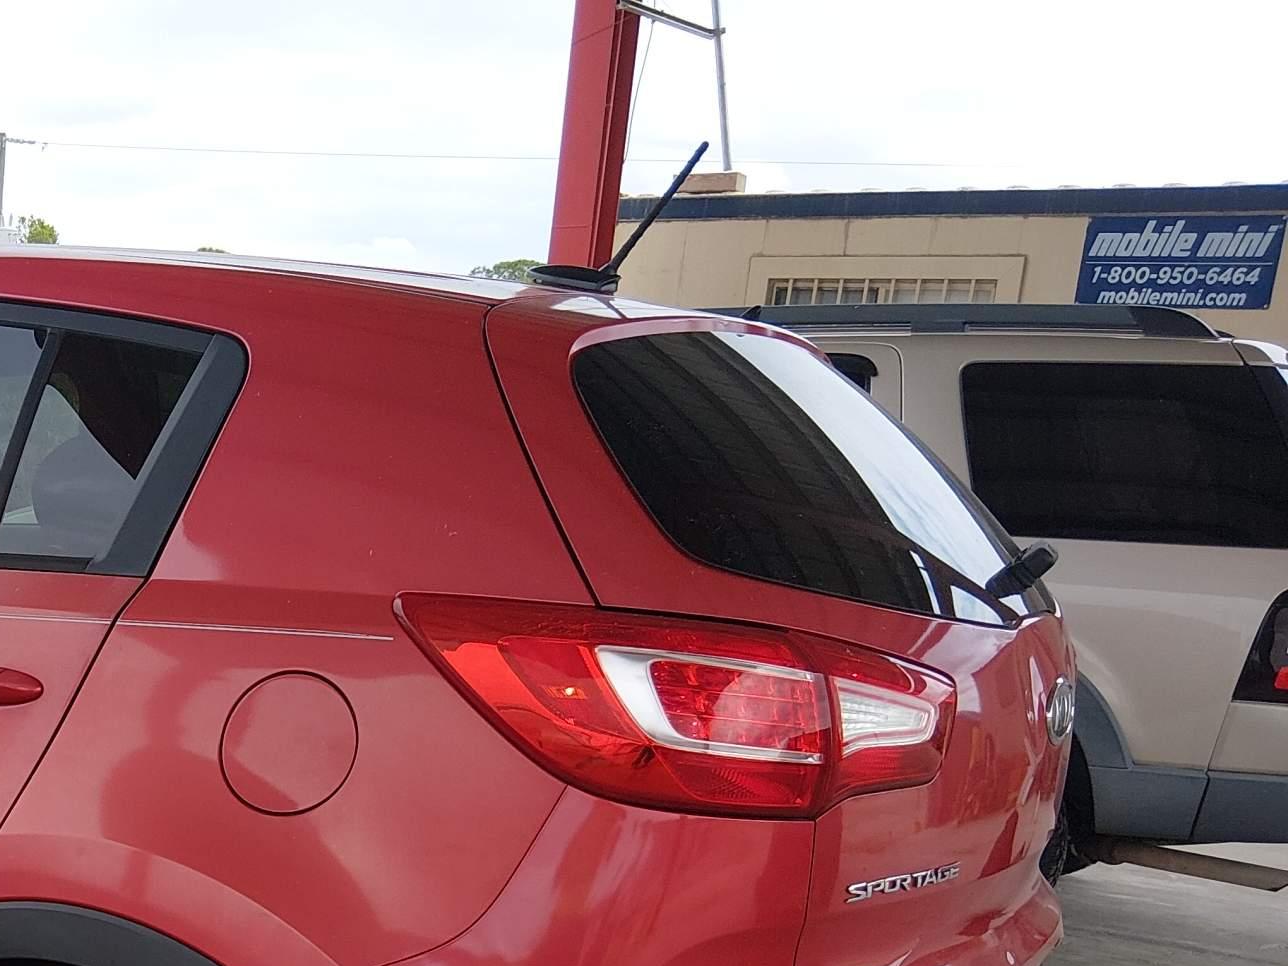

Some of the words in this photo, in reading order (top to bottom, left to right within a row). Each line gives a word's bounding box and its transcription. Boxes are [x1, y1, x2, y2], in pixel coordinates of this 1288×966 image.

[1088, 219, 1198, 257] mobile
[1196, 224, 1279, 258] mini
[1091, 266, 1261, 286] 1-800-950-6464
[1096, 287, 1247, 306] mobilemini.com
[846, 861, 961, 904] SPORTAGE
